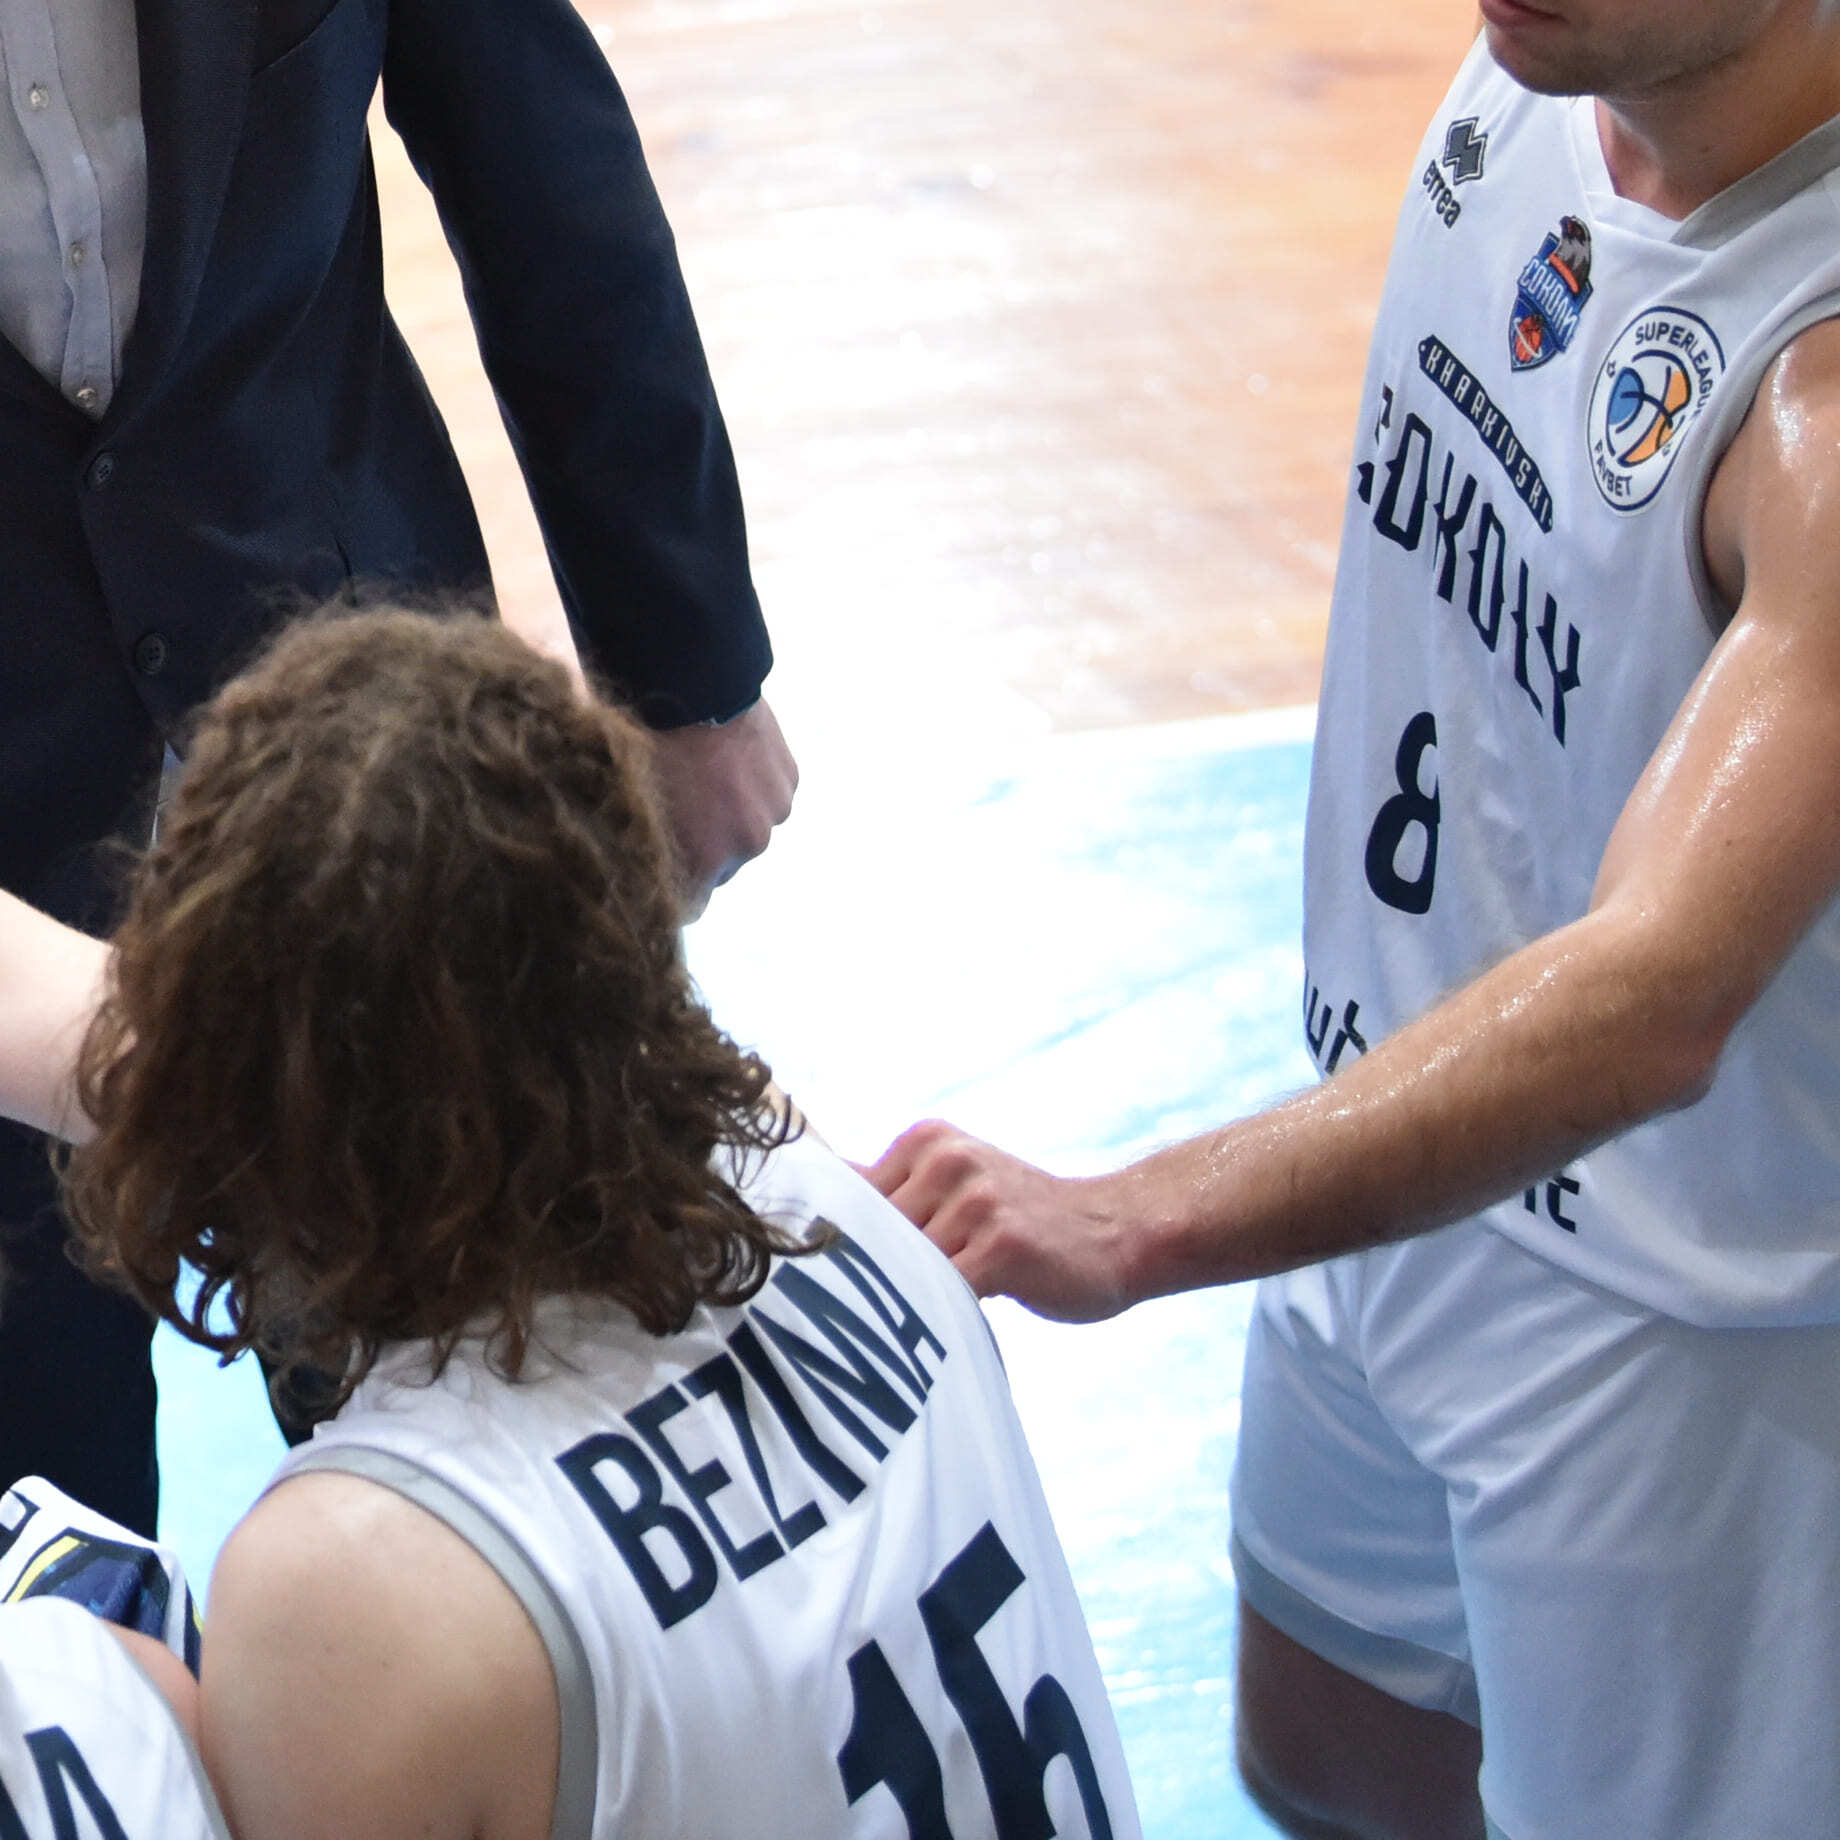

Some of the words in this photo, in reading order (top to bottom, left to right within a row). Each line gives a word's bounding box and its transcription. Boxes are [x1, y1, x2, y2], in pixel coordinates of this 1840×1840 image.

[1425, 343, 1551, 532] KHARKIVSKI
[1363, 710, 1441, 915] 8
[553, 1215, 948, 1630] BEZIMA
